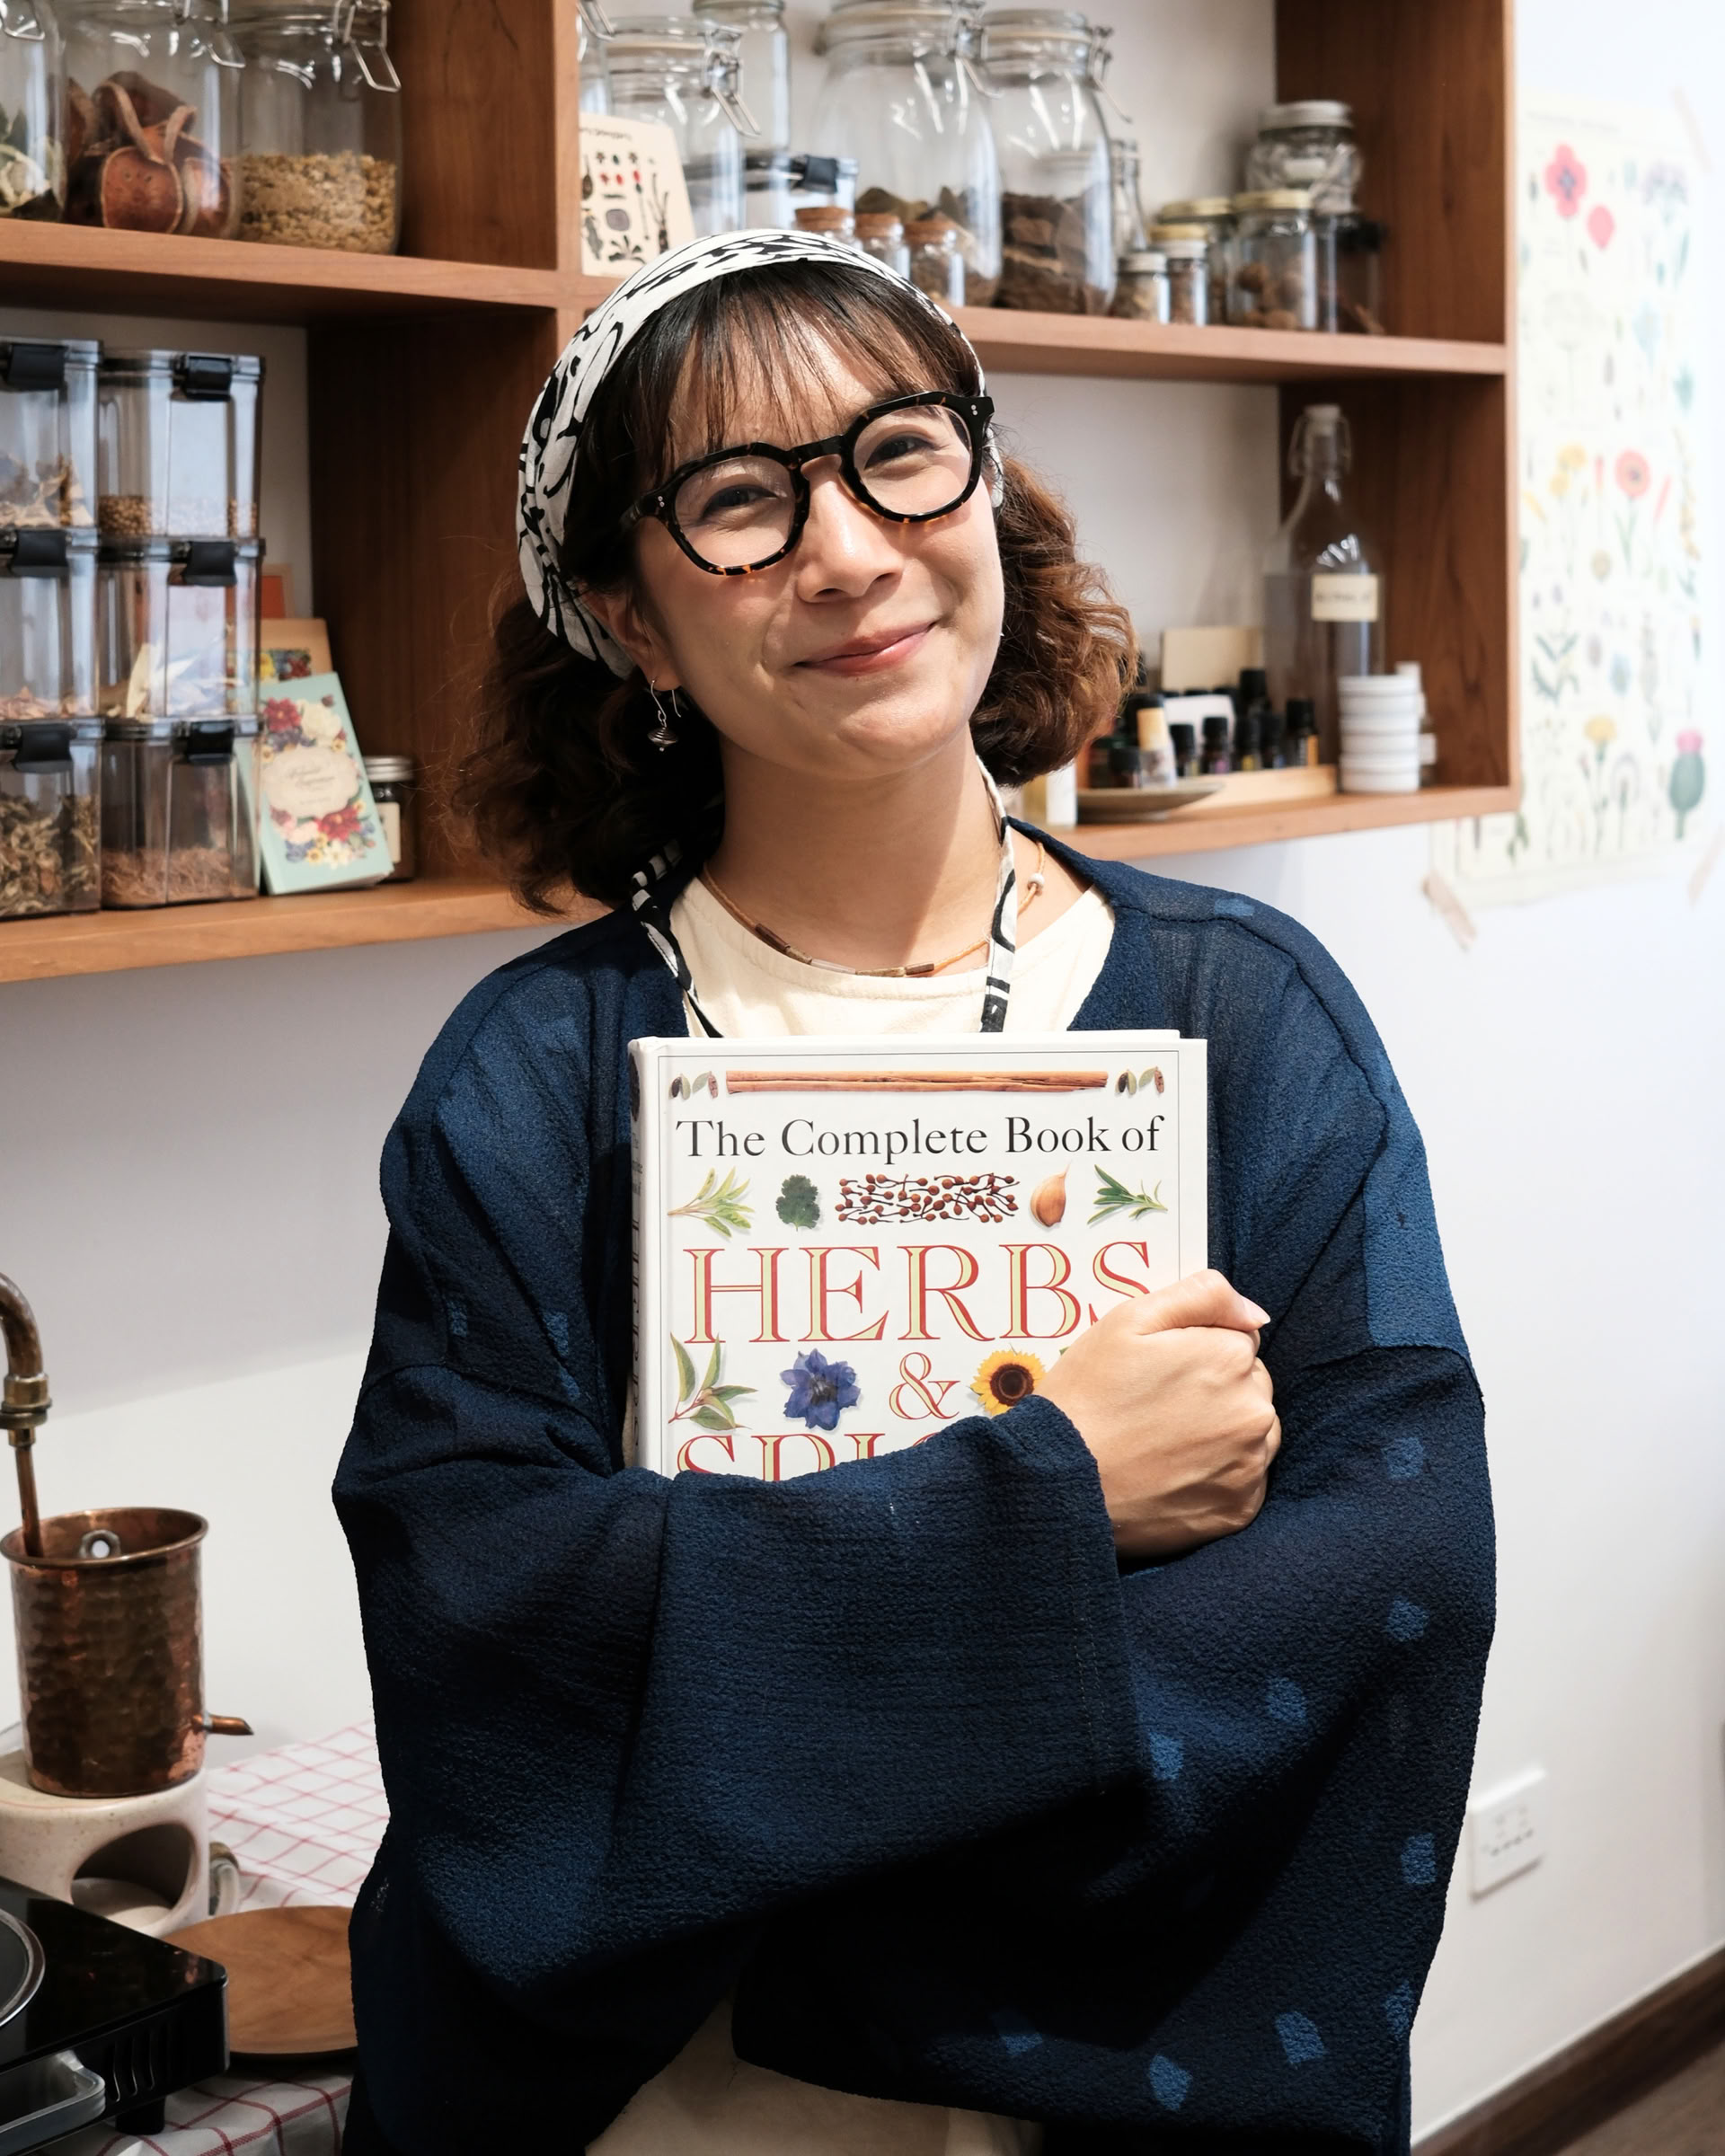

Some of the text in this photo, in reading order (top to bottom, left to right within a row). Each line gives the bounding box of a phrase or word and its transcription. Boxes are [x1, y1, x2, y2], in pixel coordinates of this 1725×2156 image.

[676, 1115, 1165, 1165] The Complete Book of
[683, 1241, 1151, 1343] HERBS
[889, 1352, 959, 1420] &
